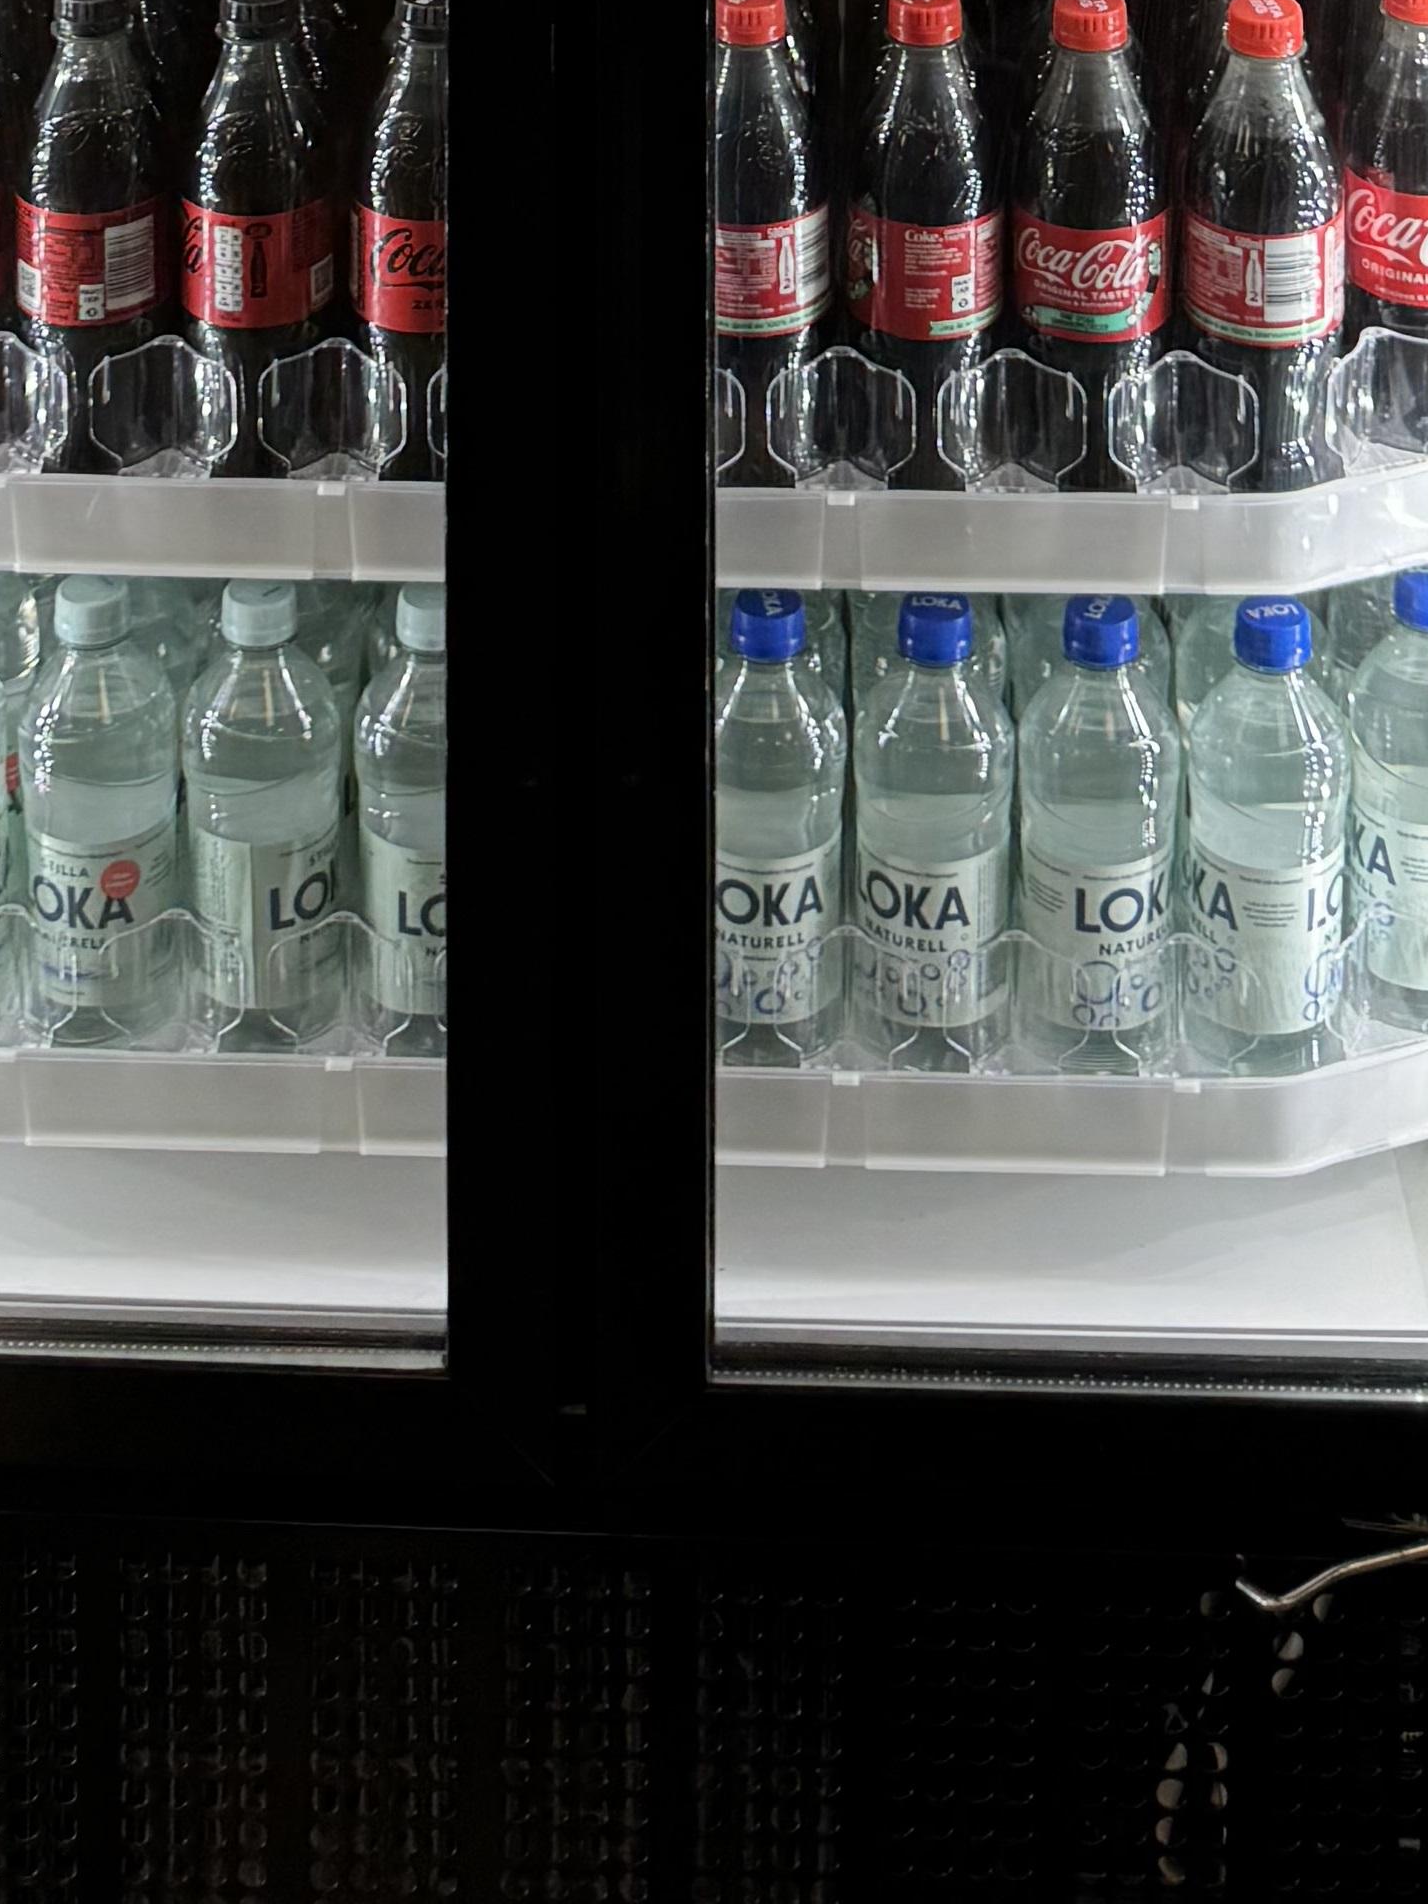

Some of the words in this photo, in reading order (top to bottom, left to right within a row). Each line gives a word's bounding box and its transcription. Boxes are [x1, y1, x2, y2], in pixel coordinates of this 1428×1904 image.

[1018, 226, 1148, 290] Coca-Cola
[1091, 290, 1131, 301] TASTE
[911, 595, 963, 611] LOKA
[1244, 603, 1301, 620] LOKA
[1353, 816, 1397, 887] KA
[33, 874, 135, 930] OKA
[269, 857, 336, 932] LO
[398, 890, 446, 938] LO
[716, 875, 824, 928] OKA
[862, 862, 971, 930] OKA
[1074, 870, 1170, 934] LOK
[1188, 859, 1239, 932] KA
